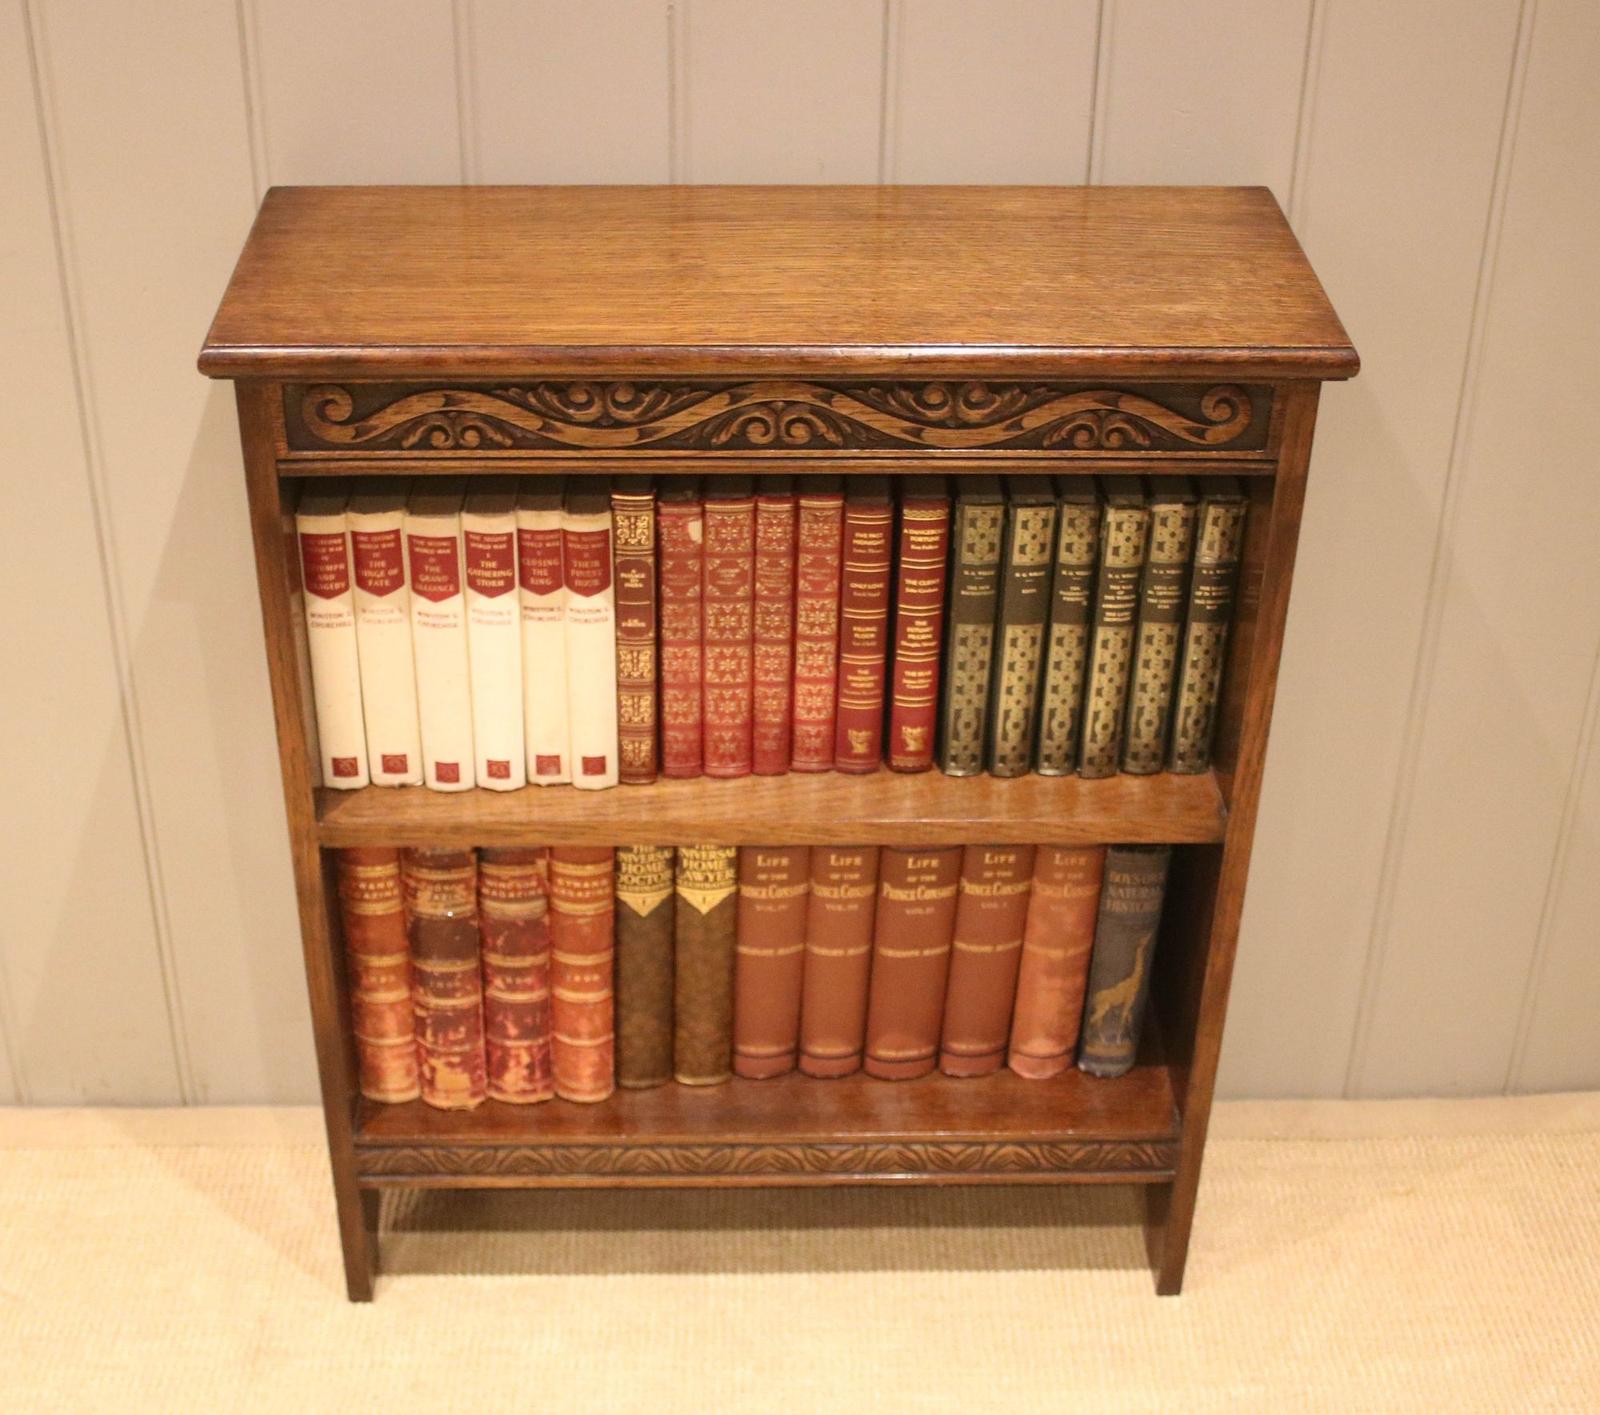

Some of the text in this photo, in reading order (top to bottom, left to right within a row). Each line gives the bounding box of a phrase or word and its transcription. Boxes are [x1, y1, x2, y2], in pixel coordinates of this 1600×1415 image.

[424, 565, 440, 573] THE
[467, 568, 513, 577] GATHERING
[476, 579, 504, 587] STORM
[622, 861, 664, 874] HOME
[683, 858, 726, 871] HOME
